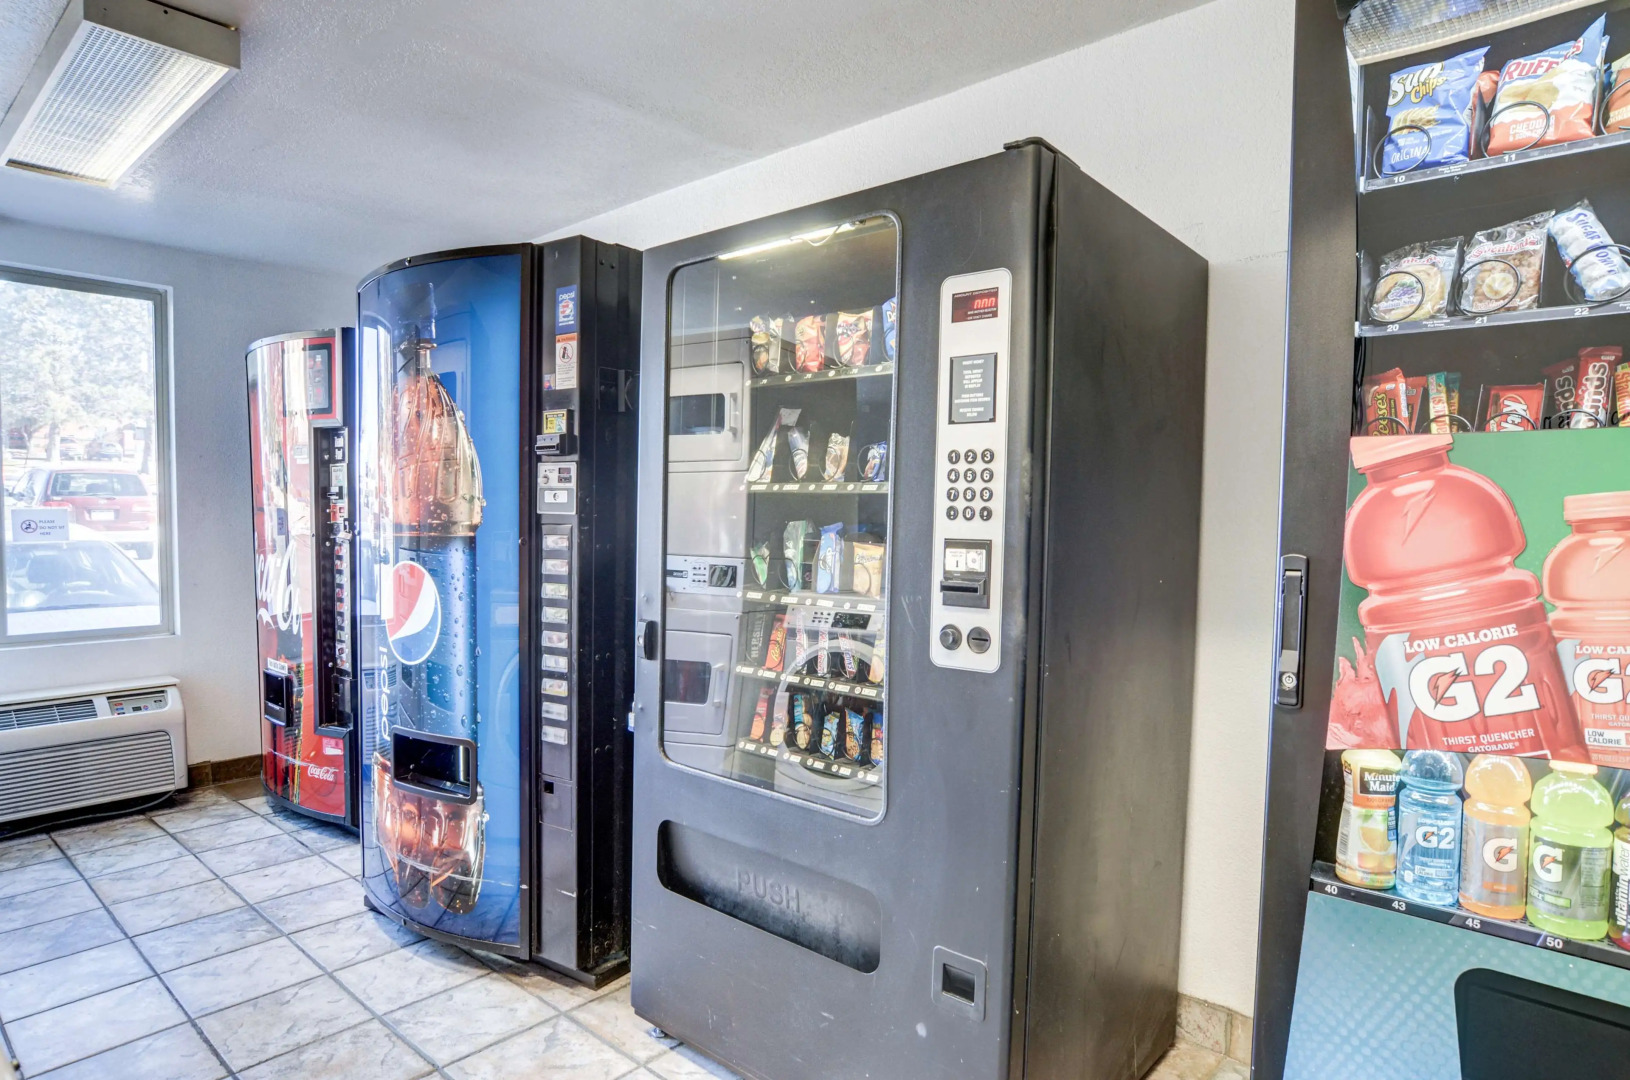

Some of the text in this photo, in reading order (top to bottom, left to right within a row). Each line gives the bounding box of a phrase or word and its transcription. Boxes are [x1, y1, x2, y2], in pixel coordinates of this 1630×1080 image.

[1388, 62, 1445, 107] Sun
[1410, 76, 1447, 104] Chips
[1509, 114, 1556, 134] CHEDDR
[1391, 145, 1431, 164] ORIGINA
[1503, 154, 1517, 162] 11
[1393, 175, 1406, 184] 10
[1566, 212, 1602, 241] SUGAR
[558, 291, 576, 301] pepsi
[1574, 307, 1589, 316] 22
[1475, 316, 1488, 325] 21
[1386, 323, 1399, 332] 20
[1576, 362, 1609, 429] ounds
[951, 451, 991, 461] 1 2 3
[950, 471, 990, 480] 4 5 6
[950, 490, 989, 499] 7 8 9
[965, 508, 972, 517] 0
[1402, 623, 1519, 654] LOW CALORIE
[1575, 645, 1604, 655] LOW
[1408, 644, 1542, 722] G2
[1573, 657, 1630, 705] G
[379, 646, 391, 741] pepsi
[1591, 713, 1630, 722] THIRST QU
[1441, 727, 1536, 747] THIRST QUENCHER
[1588, 737, 1622, 746] CALORIE
[1363, 771, 1401, 782] Minute
[1369, 780, 1395, 792] Maid
[1415, 825, 1455, 849] G2
[1482, 837, 1518, 873] G
[1532, 844, 1563, 883] G
[736, 867, 801, 914] PUSH
[1324, 884, 1338, 895] 40
[1391, 900, 1406, 912] 43
[1465, 918, 1481, 930] 45
[1546, 937, 1564, 949] 50
